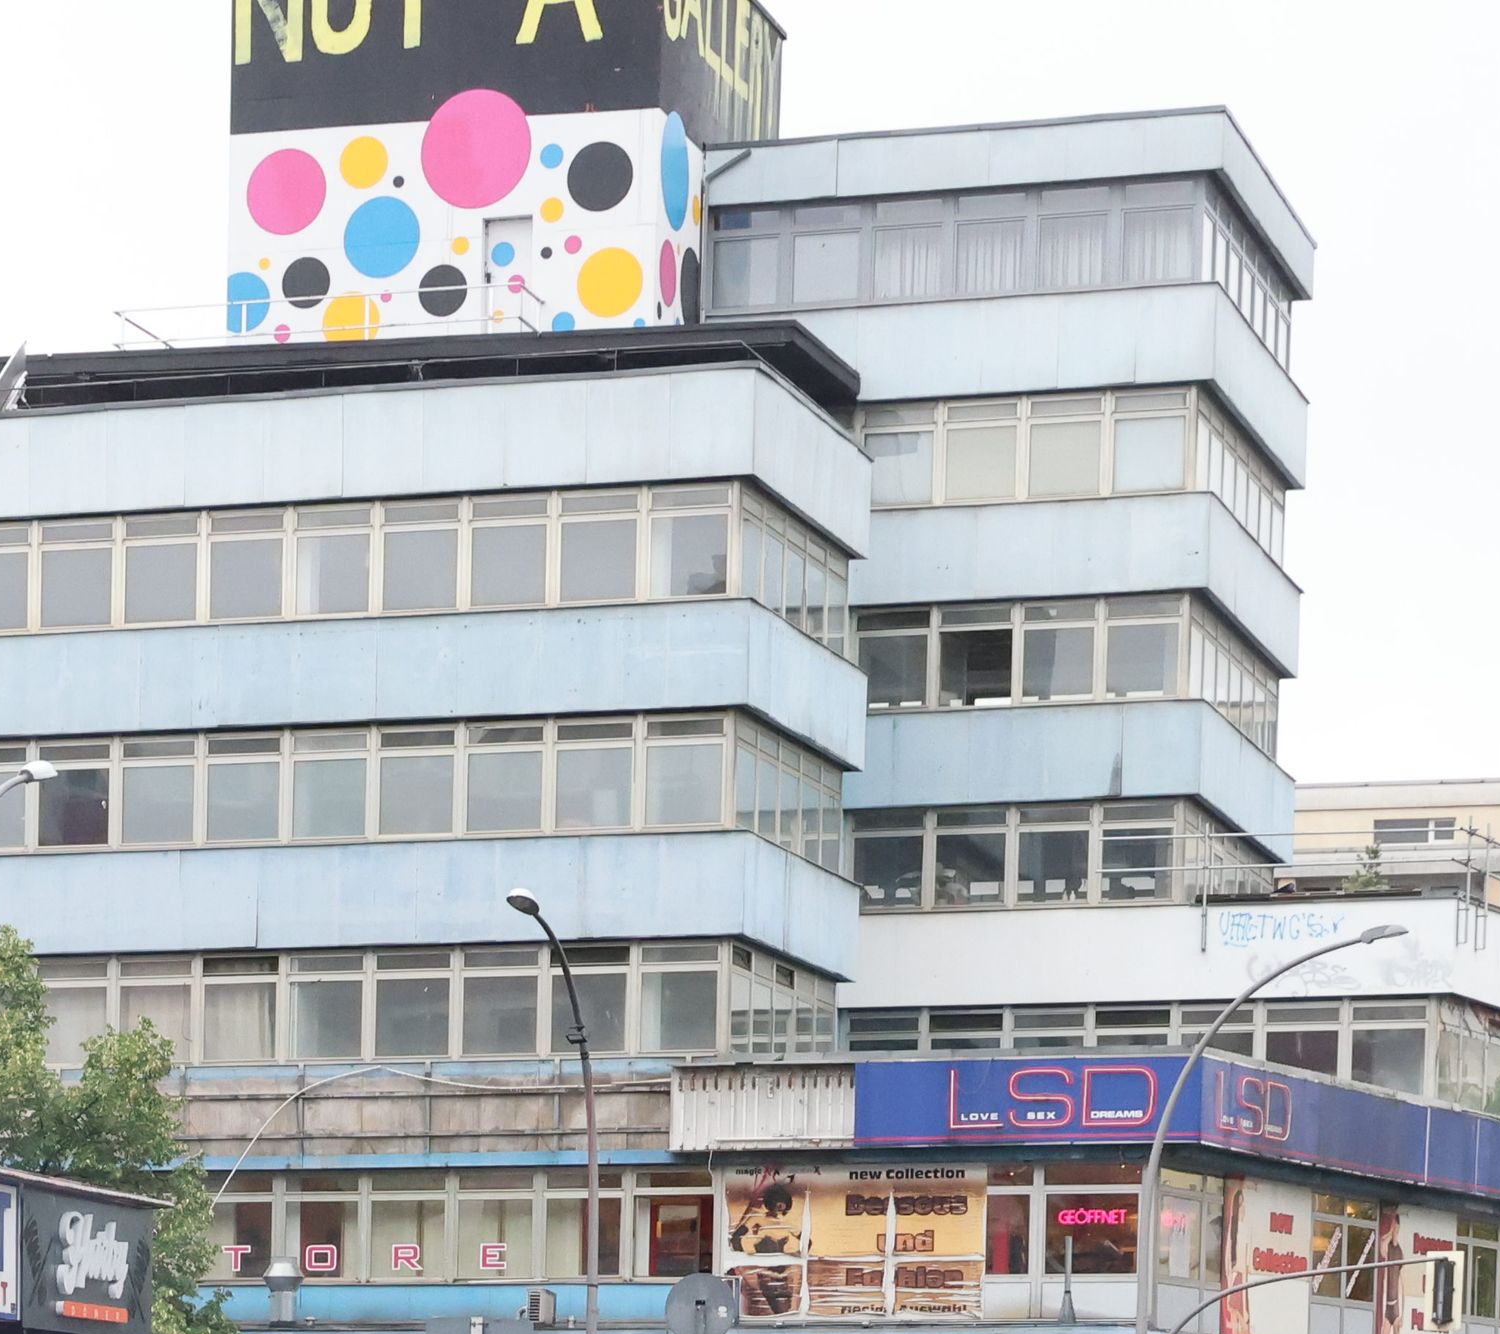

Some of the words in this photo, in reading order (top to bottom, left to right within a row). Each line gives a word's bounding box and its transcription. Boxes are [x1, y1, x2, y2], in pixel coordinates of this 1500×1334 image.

[948, 1064, 1159, 1131] LSD
[1216, 1070, 1292, 1142] LSD
[960, 1112, 999, 1122] LOVE
[1026, 1110, 1057, 1121] SEX
[1090, 1109, 1144, 1120] DREAMS
[848, 1169, 882, 1181] new
[885, 1167, 966, 1180] Collection
[1058, 1208, 1128, 1226] GEÖFFNET
[845, 1266, 964, 1289] Fahion
